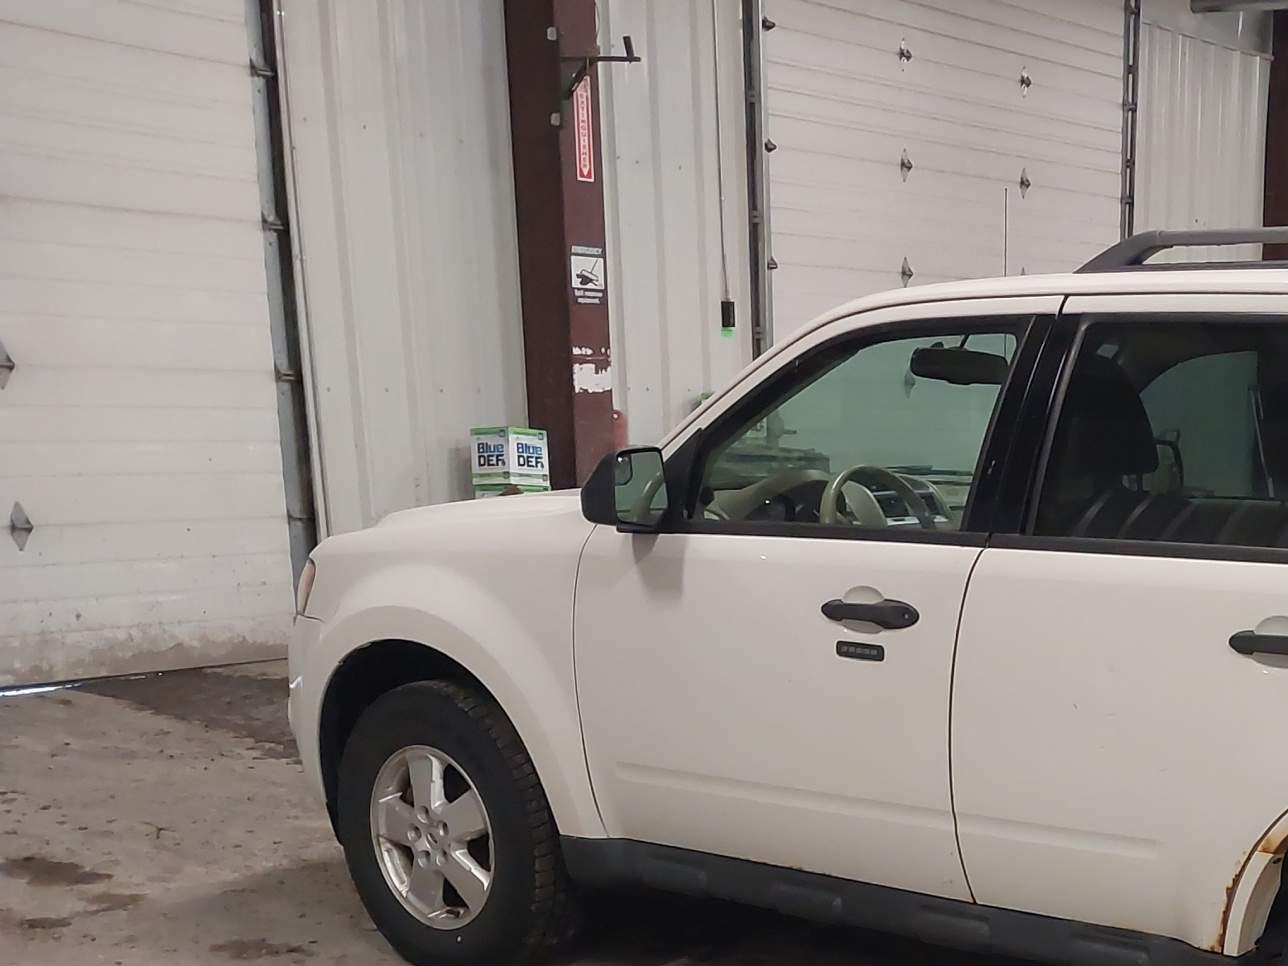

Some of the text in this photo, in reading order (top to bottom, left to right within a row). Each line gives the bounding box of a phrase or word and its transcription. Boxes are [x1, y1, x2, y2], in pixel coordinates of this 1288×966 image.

[477, 442, 504, 454] Blue
[516, 442, 543, 456] Blue
[478, 454, 505, 467] DEF
[517, 455, 544, 468] DEF
